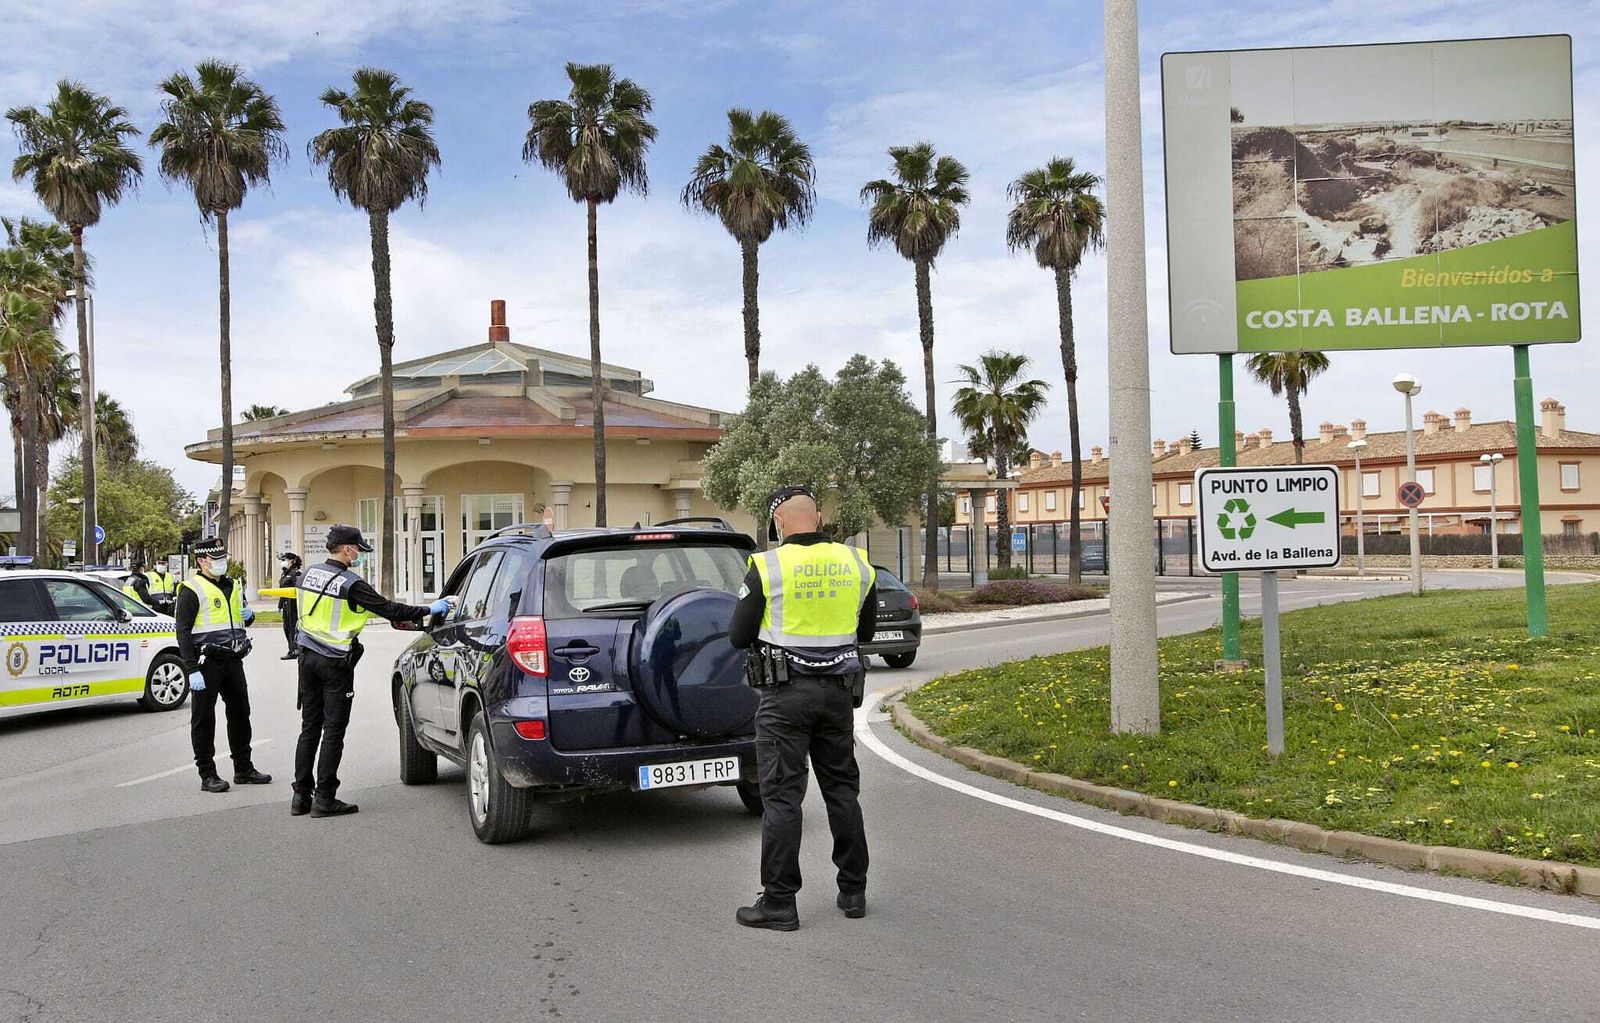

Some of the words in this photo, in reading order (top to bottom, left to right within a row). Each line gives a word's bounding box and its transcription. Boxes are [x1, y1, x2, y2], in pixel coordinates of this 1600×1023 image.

[1401, 265, 1533, 288] Bienvenidos
[1540, 267, 1554, 283] a
[1246, 309, 1335, 329] COSTA
[1211, 479, 1268, 494] PUNTO
[1276, 477, 1329, 492] LIMPIO
[1211, 550, 1241, 562] Avd.
[1245, 550, 1262, 560] de
[1266, 549, 1278, 560] la
[1283, 547, 1333, 559] Ballena
[794, 563, 852, 577] POLICIA
[795, 579, 822, 588] Local
[829, 579, 852, 587] Rota
[40, 642, 129, 665] POLICIA
[39, 666, 69, 675] LOCAL
[52, 685, 90, 698] ROTA
[577, 683, 610, 692] RAV4
[653, 764, 695, 784] 9831
[703, 760, 735, 779] FRP
